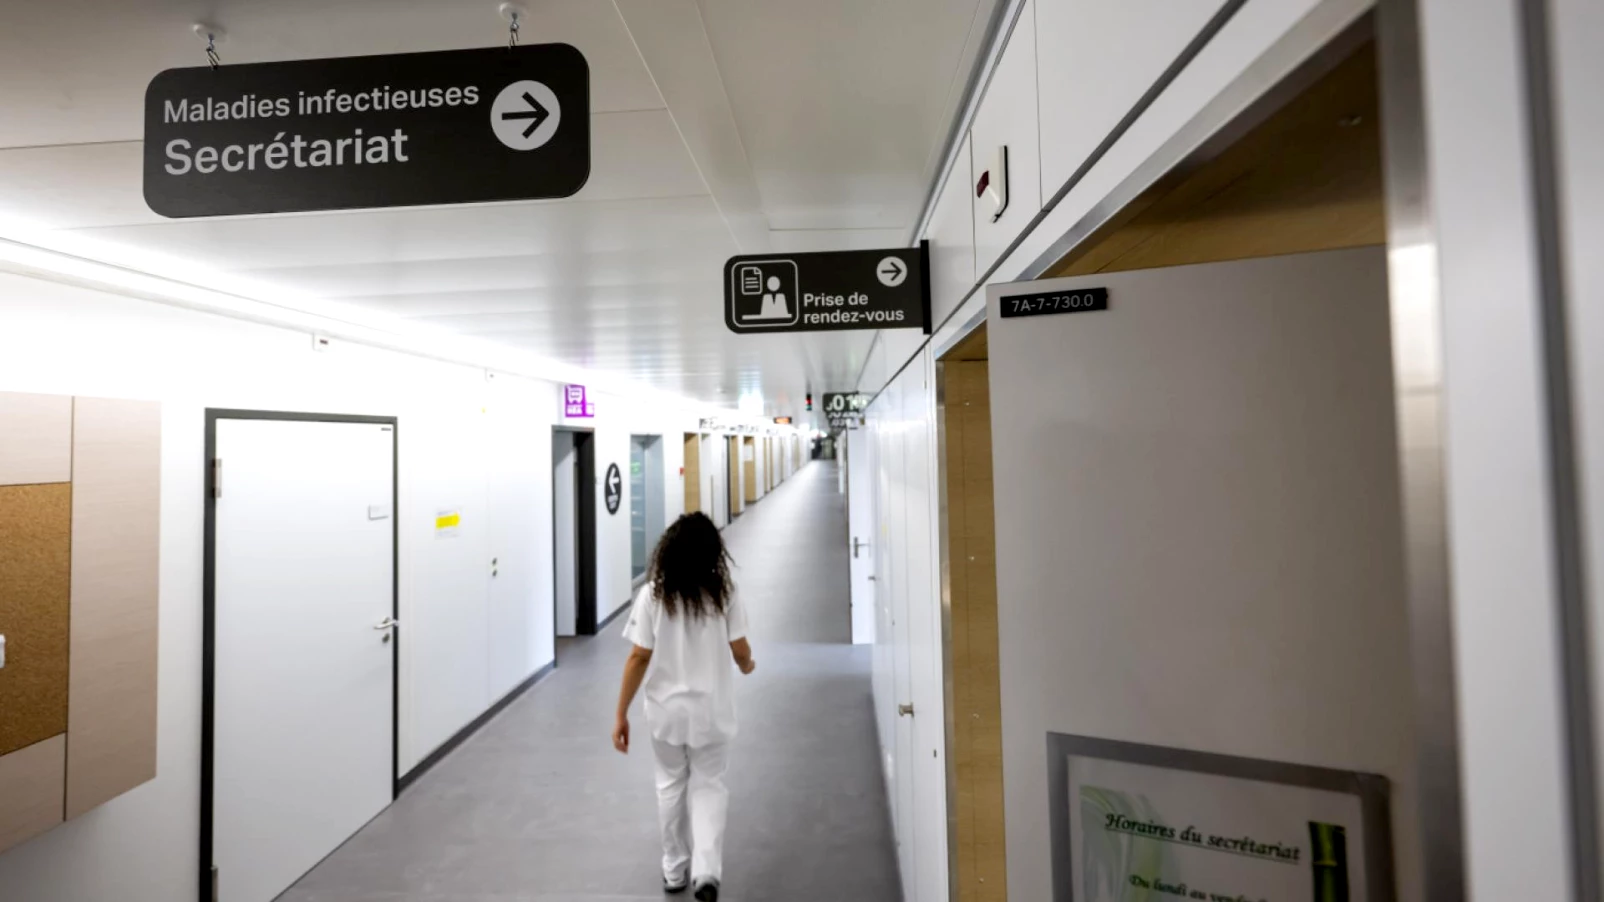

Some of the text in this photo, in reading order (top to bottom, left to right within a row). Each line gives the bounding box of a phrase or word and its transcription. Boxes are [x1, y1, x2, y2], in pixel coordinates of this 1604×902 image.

[163, 85, 480, 124] Maladies infectieuses
[163, 127, 410, 176] Secrétariat
[803, 292, 869, 307] Prise de
[1011, 293, 1094, 313] 7A-7-730.0
[803, 309, 905, 325] rendez-vous
[1104, 812, 1301, 862] Horaires du secrétariat
[1128, 874, 1150, 889] Du
[1153, 877, 1187, 897] lundi
[1190, 889, 1206, 900] au
